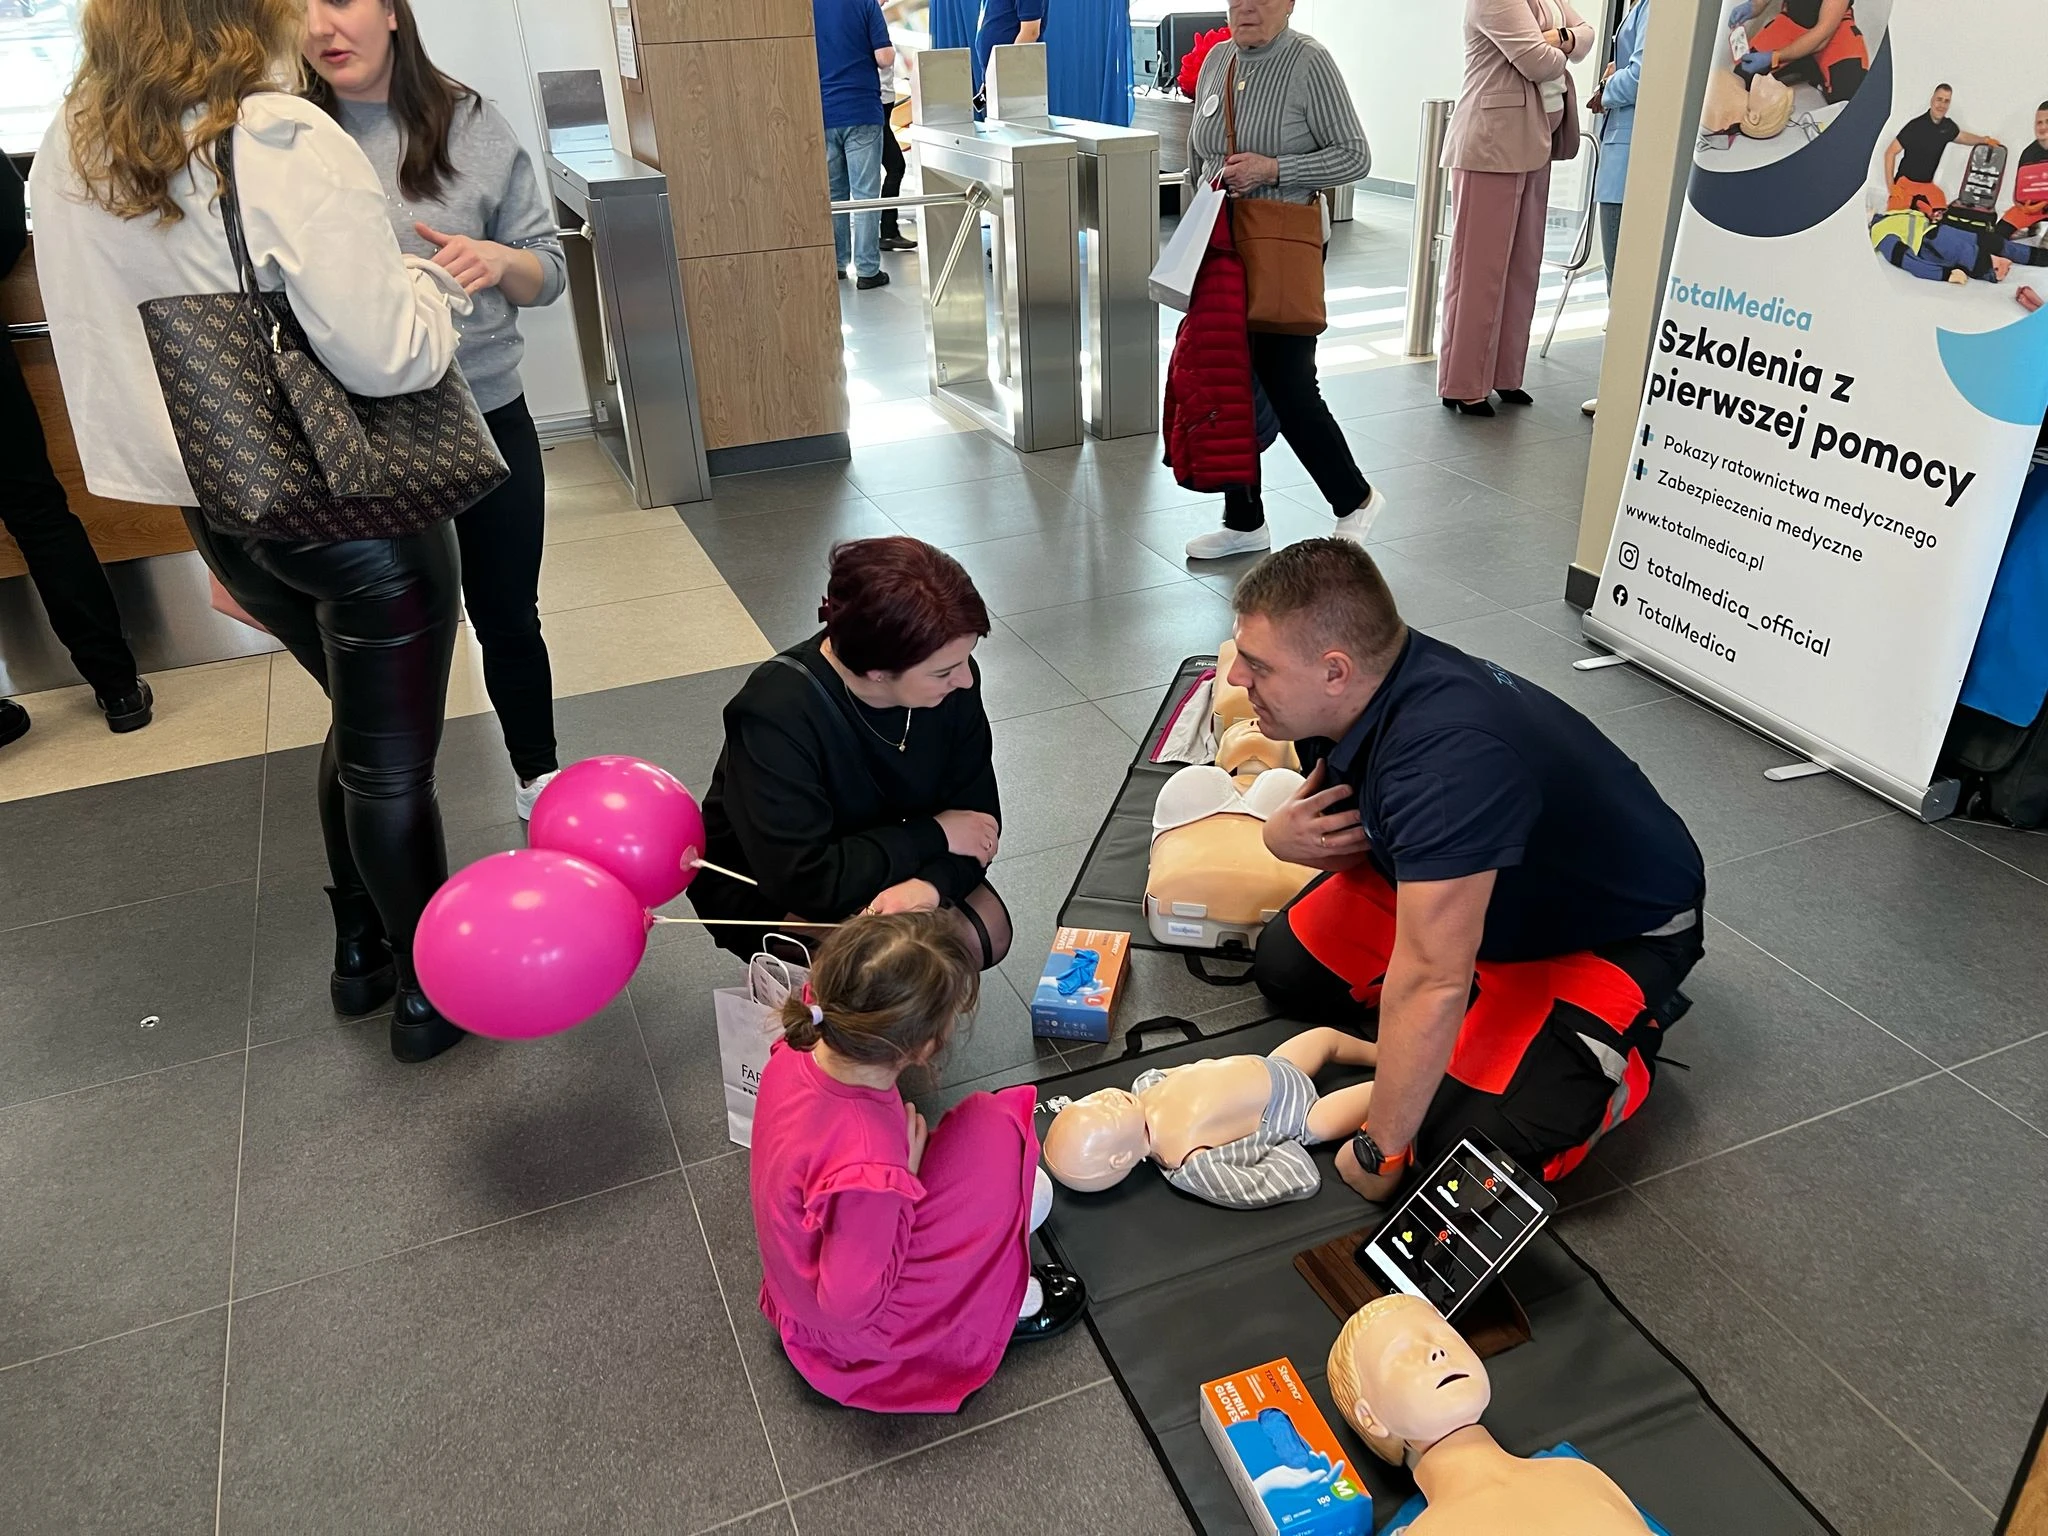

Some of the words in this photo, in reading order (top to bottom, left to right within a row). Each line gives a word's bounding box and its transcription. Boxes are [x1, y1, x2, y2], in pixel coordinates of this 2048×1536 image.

[1670, 276, 1813, 332] TotalMedica
[1659, 318, 1824, 394] Szkolenia
[1830, 372, 1855, 404] z
[1646, 367, 1808, 451] pierwszej
[1810, 422, 1977, 508] pomocy
[1657, 469, 1773, 527] Zabezpieczenia
[1776, 518, 1863, 562] medyczne
[1663, 434, 1720, 470] Pokazy
[1721, 456, 1820, 504] ratownictwa
[1823, 494, 1938, 549] medycznego
[1626, 504, 1765, 571] www.totalmedica.pl
[1637, 597, 1737, 662] TotalMedica
[1647, 557, 1831, 657] totalmedica_official
[1214, 1384, 1241, 1423] GLOVES
[1223, 1380, 1250, 1418] NITRILE
[1316, 1495, 1331, 1506] 100
[1333, 1479, 1355, 1497] M
